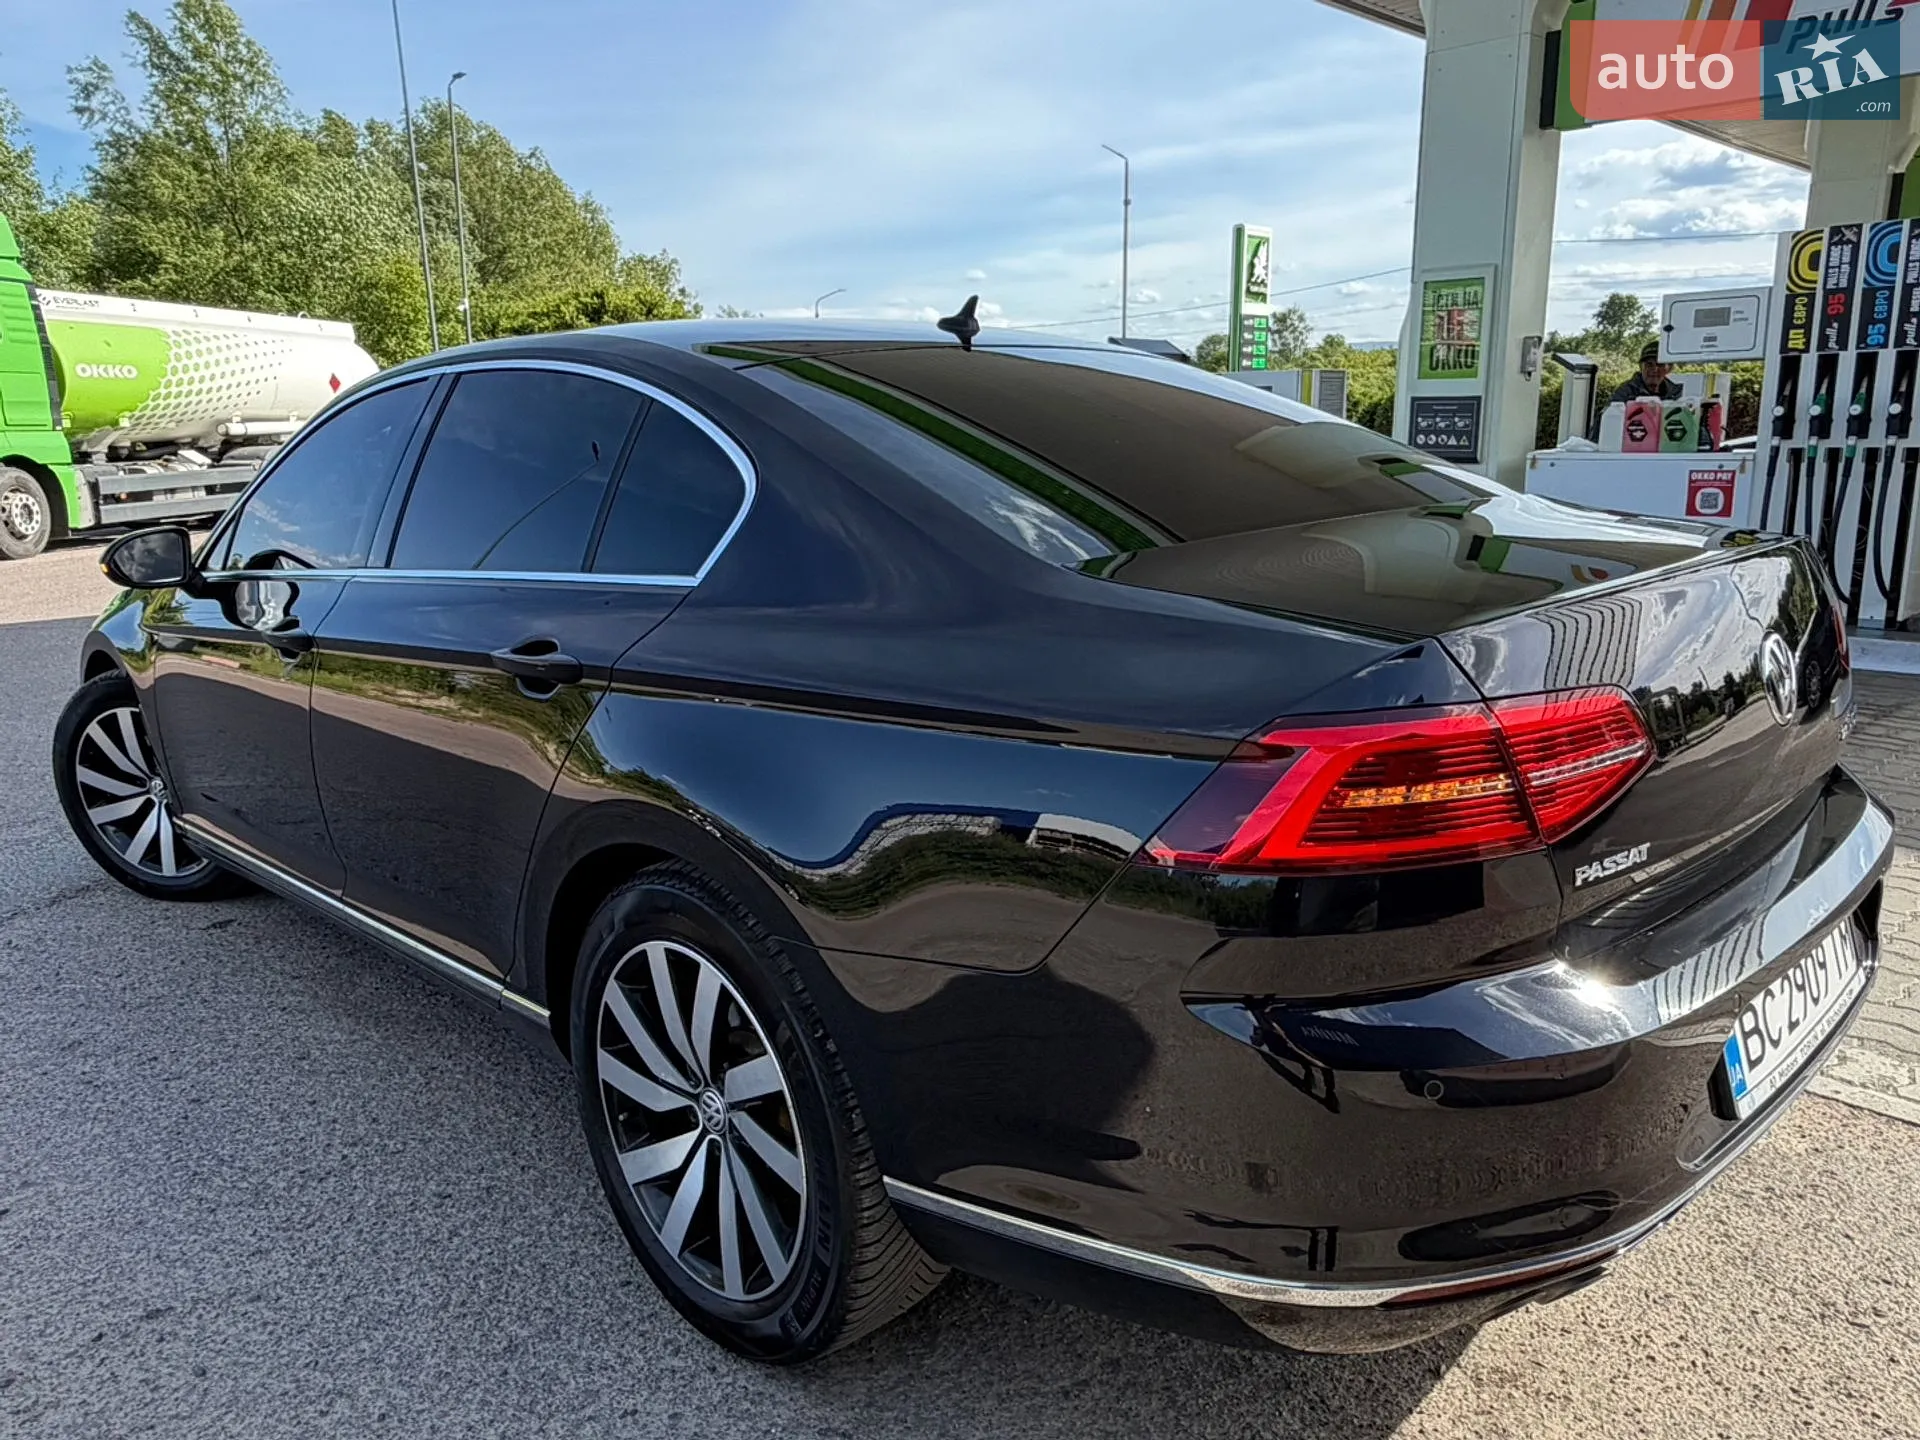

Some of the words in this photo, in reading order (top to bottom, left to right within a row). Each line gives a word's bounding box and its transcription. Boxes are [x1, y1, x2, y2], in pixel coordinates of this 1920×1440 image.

[1827, 293, 1845, 315] 95
[1787, 329, 1806, 350] ДП
[1866, 323, 1886, 346] 95
[75, 363, 138, 379] OKKO
[1574, 842, 1651, 887] PASSAT
